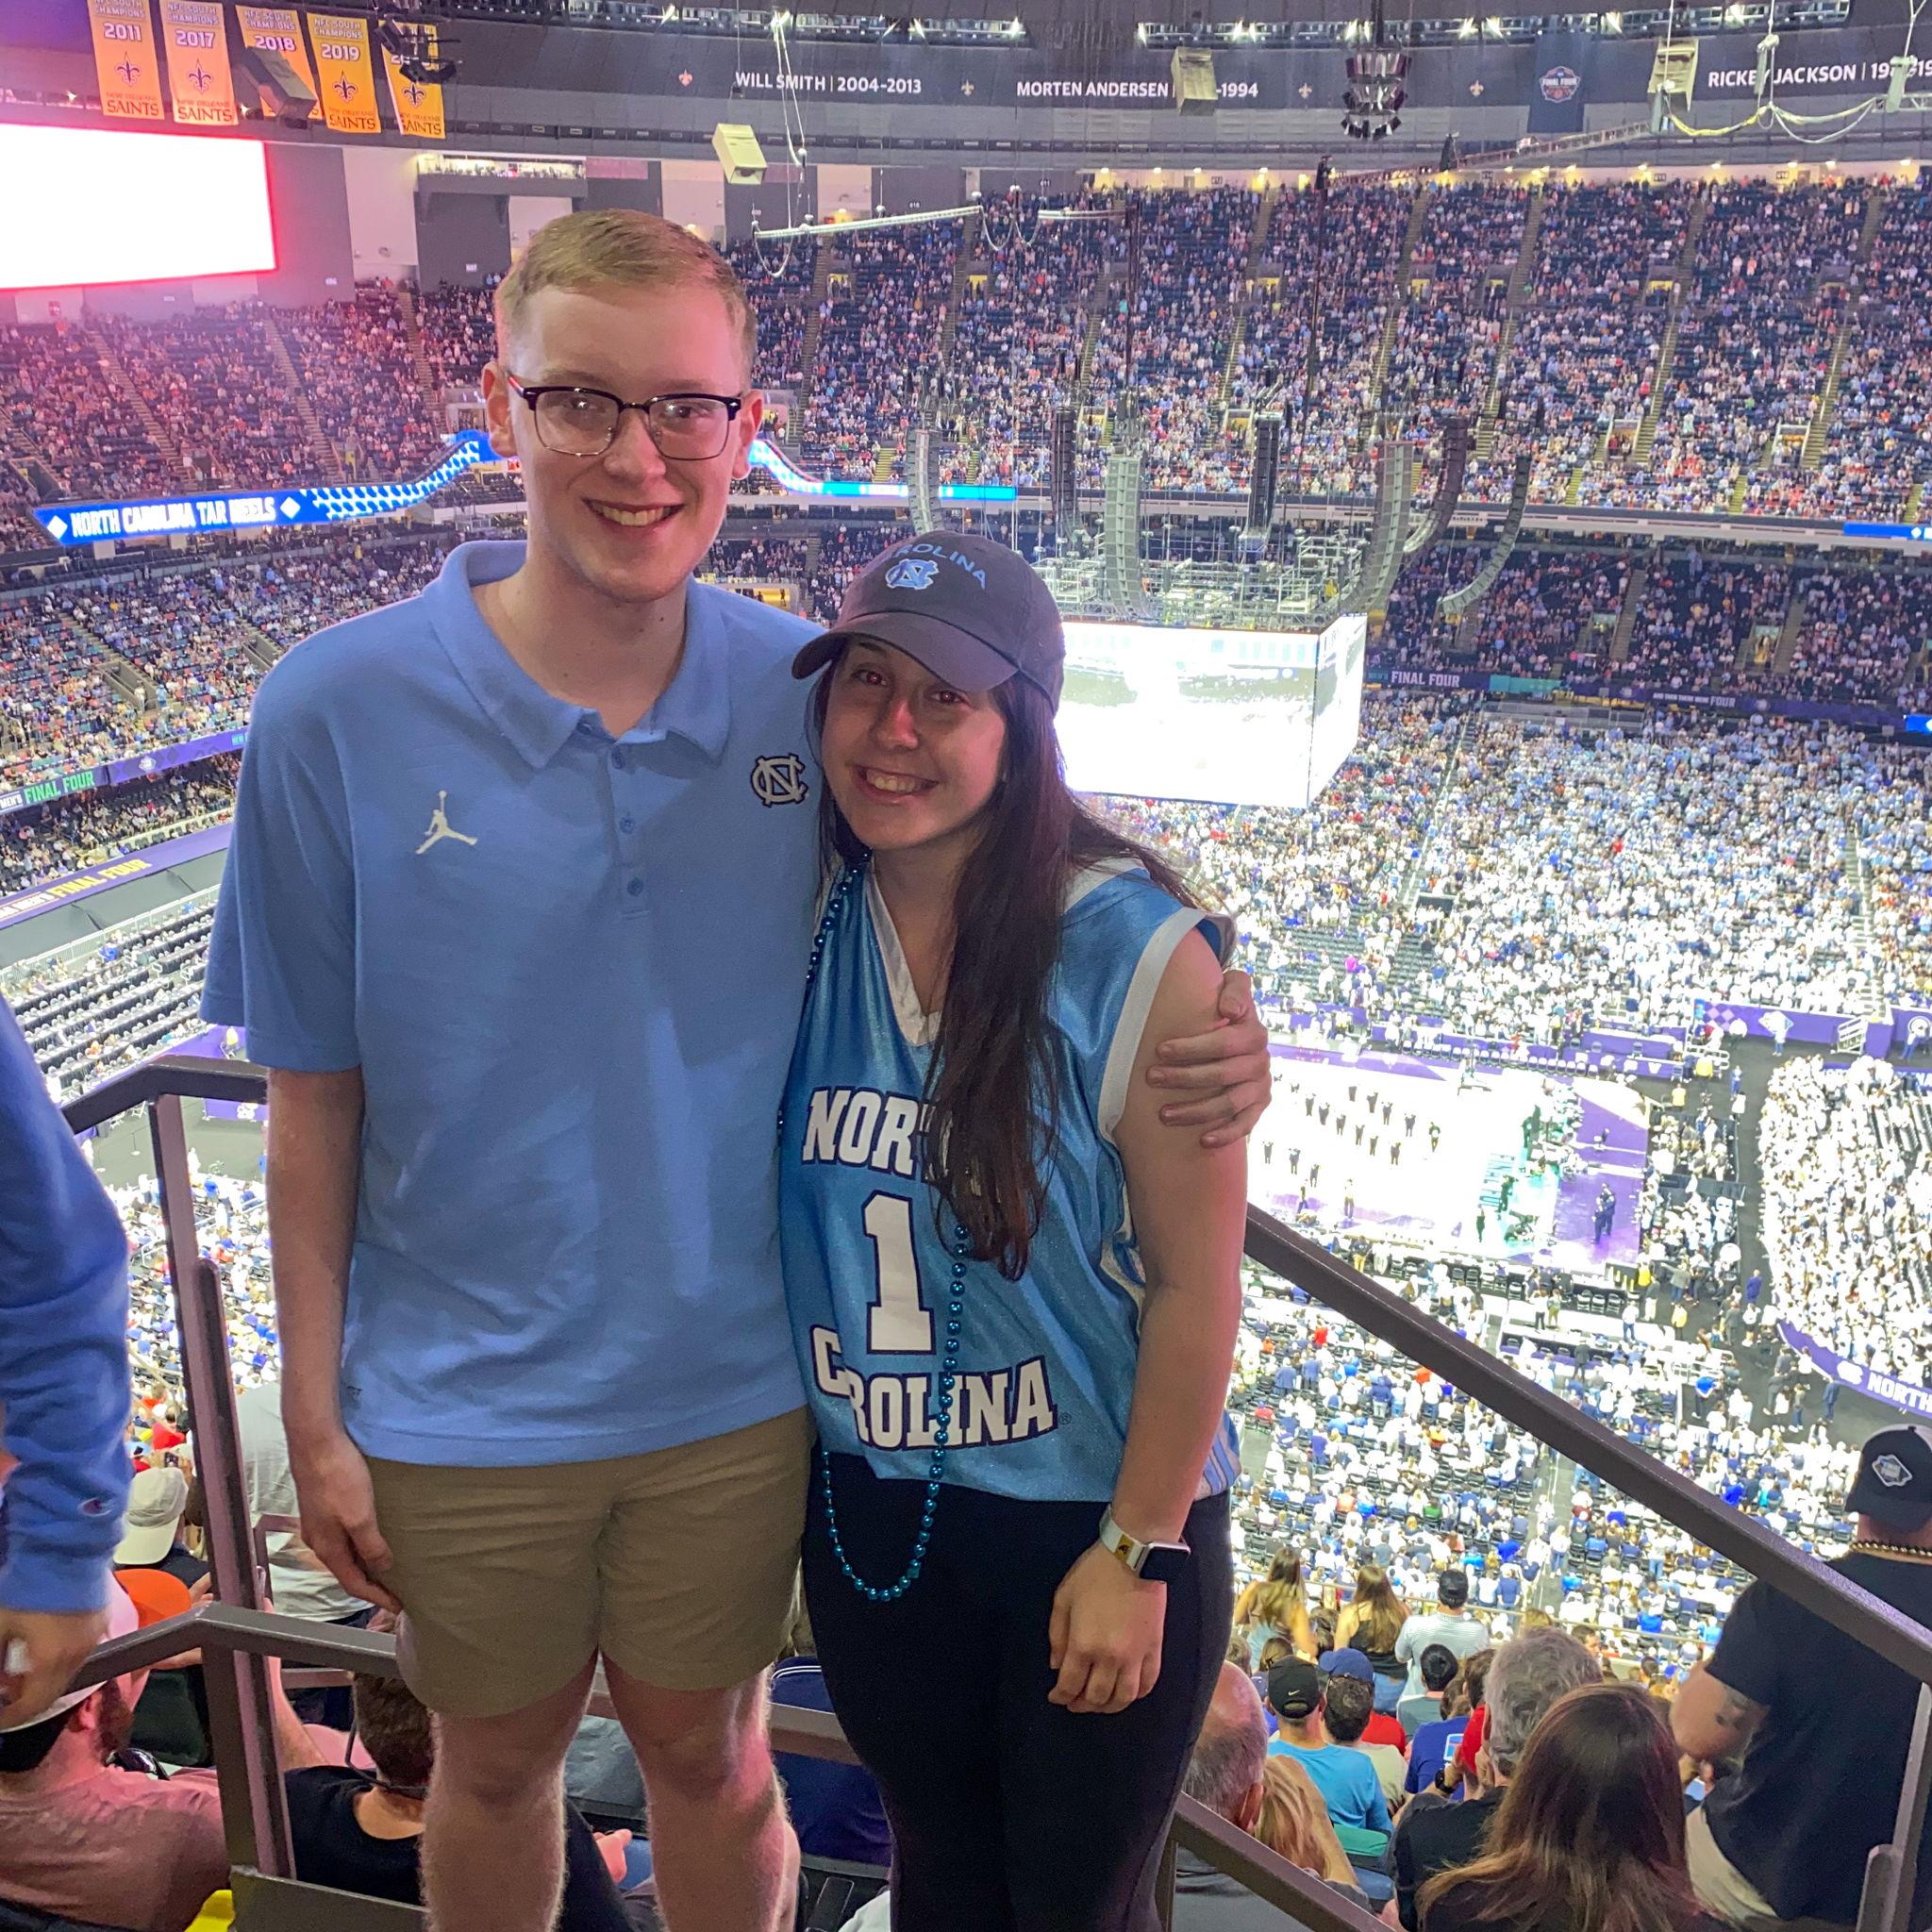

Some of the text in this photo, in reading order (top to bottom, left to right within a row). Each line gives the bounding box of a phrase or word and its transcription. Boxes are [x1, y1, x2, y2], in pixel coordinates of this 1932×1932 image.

[103, 23, 142, 42] 2011
[175, 29, 215, 47] 2017
[254, 35, 296, 51] 2018
[321, 42, 361, 60] 2019
[736, 72, 923, 93] WILL SMITH 2004-2013
[1773, 64, 1857, 85] JACKSON
[1017, 81, 1083, 97] MORTEN
[1085, 82, 1169, 98] ANDERSEN
[107, 100, 159, 116] SAINTS
[177, 107, 233, 123] SAINTS
[329, 114, 376, 130] SAINTS
[70, 509, 121, 537] NORTH
[196, 501, 227, 525] TAR
[1391, 671, 1425, 685] FINAL
[1428, 673, 1460, 688] FOUR
[1709, 696, 1736, 708] FOUR
[24, 781, 62, 805] FINAL
[62, 771, 95, 792] FOUR
[48, 874, 108, 898] FINAL
[98, 858, 153, 880] FOUR
[861, 1189, 937, 1355] 1
